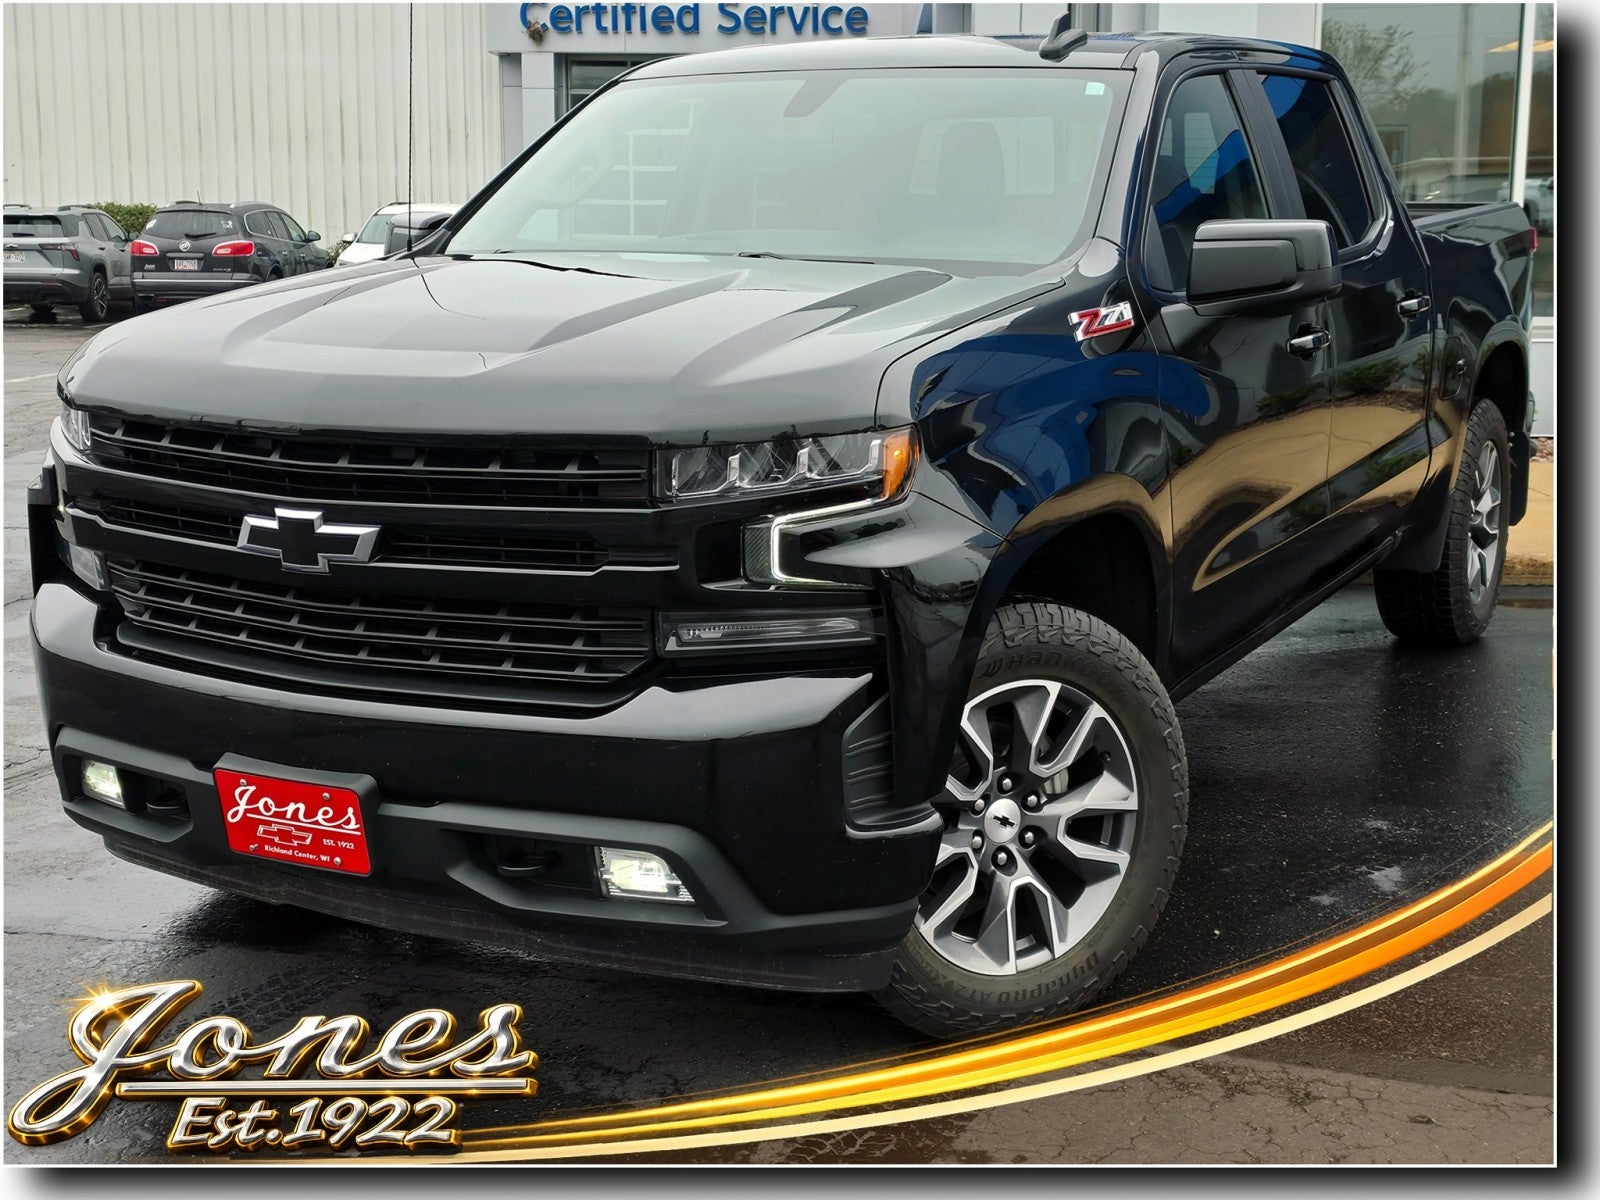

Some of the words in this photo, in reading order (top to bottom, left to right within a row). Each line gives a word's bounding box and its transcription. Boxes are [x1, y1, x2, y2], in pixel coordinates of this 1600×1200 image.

[520, 3, 700, 34] Certified
[717, 3, 869, 34] Service
[1067, 300, 1135, 342] Z71
[226, 785, 361, 829] Jones
[264, 844, 293, 856] Richland
[293, 850, 319, 862] Center,
[319, 854, 330, 862] WI
[323, 839, 336, 847] EST.
[337, 840, 355, 850] 1922
